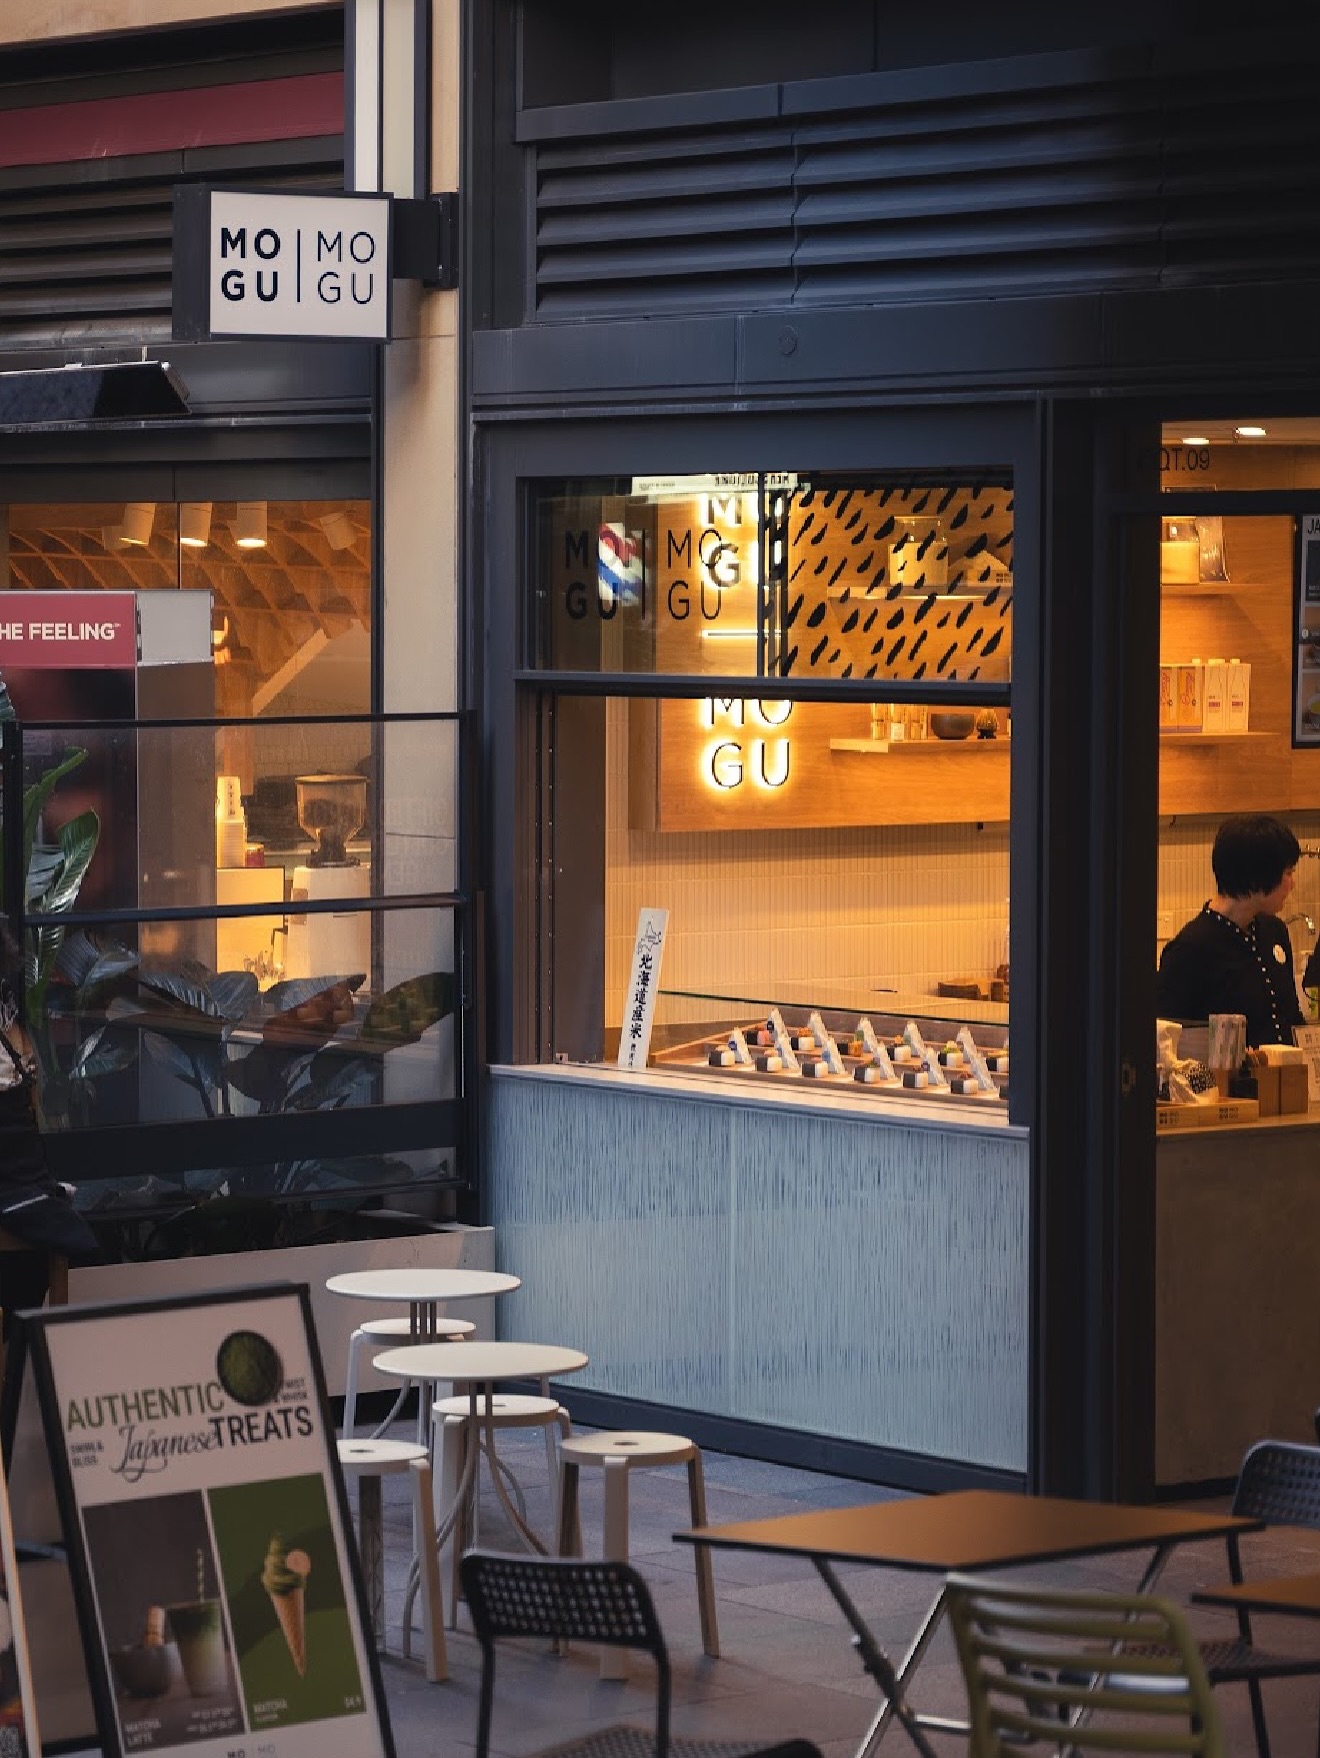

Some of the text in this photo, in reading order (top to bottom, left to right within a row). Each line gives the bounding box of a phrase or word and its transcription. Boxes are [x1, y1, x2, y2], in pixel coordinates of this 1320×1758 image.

[221, 228, 375, 264] MO MO
[221, 269, 374, 304] GU GU
[667, 580, 722, 620] GU
[711, 742, 790, 788] GU
[67, 1381, 226, 1433] AUTHENTIC
[208, 1406, 313, 1449] TREATS
